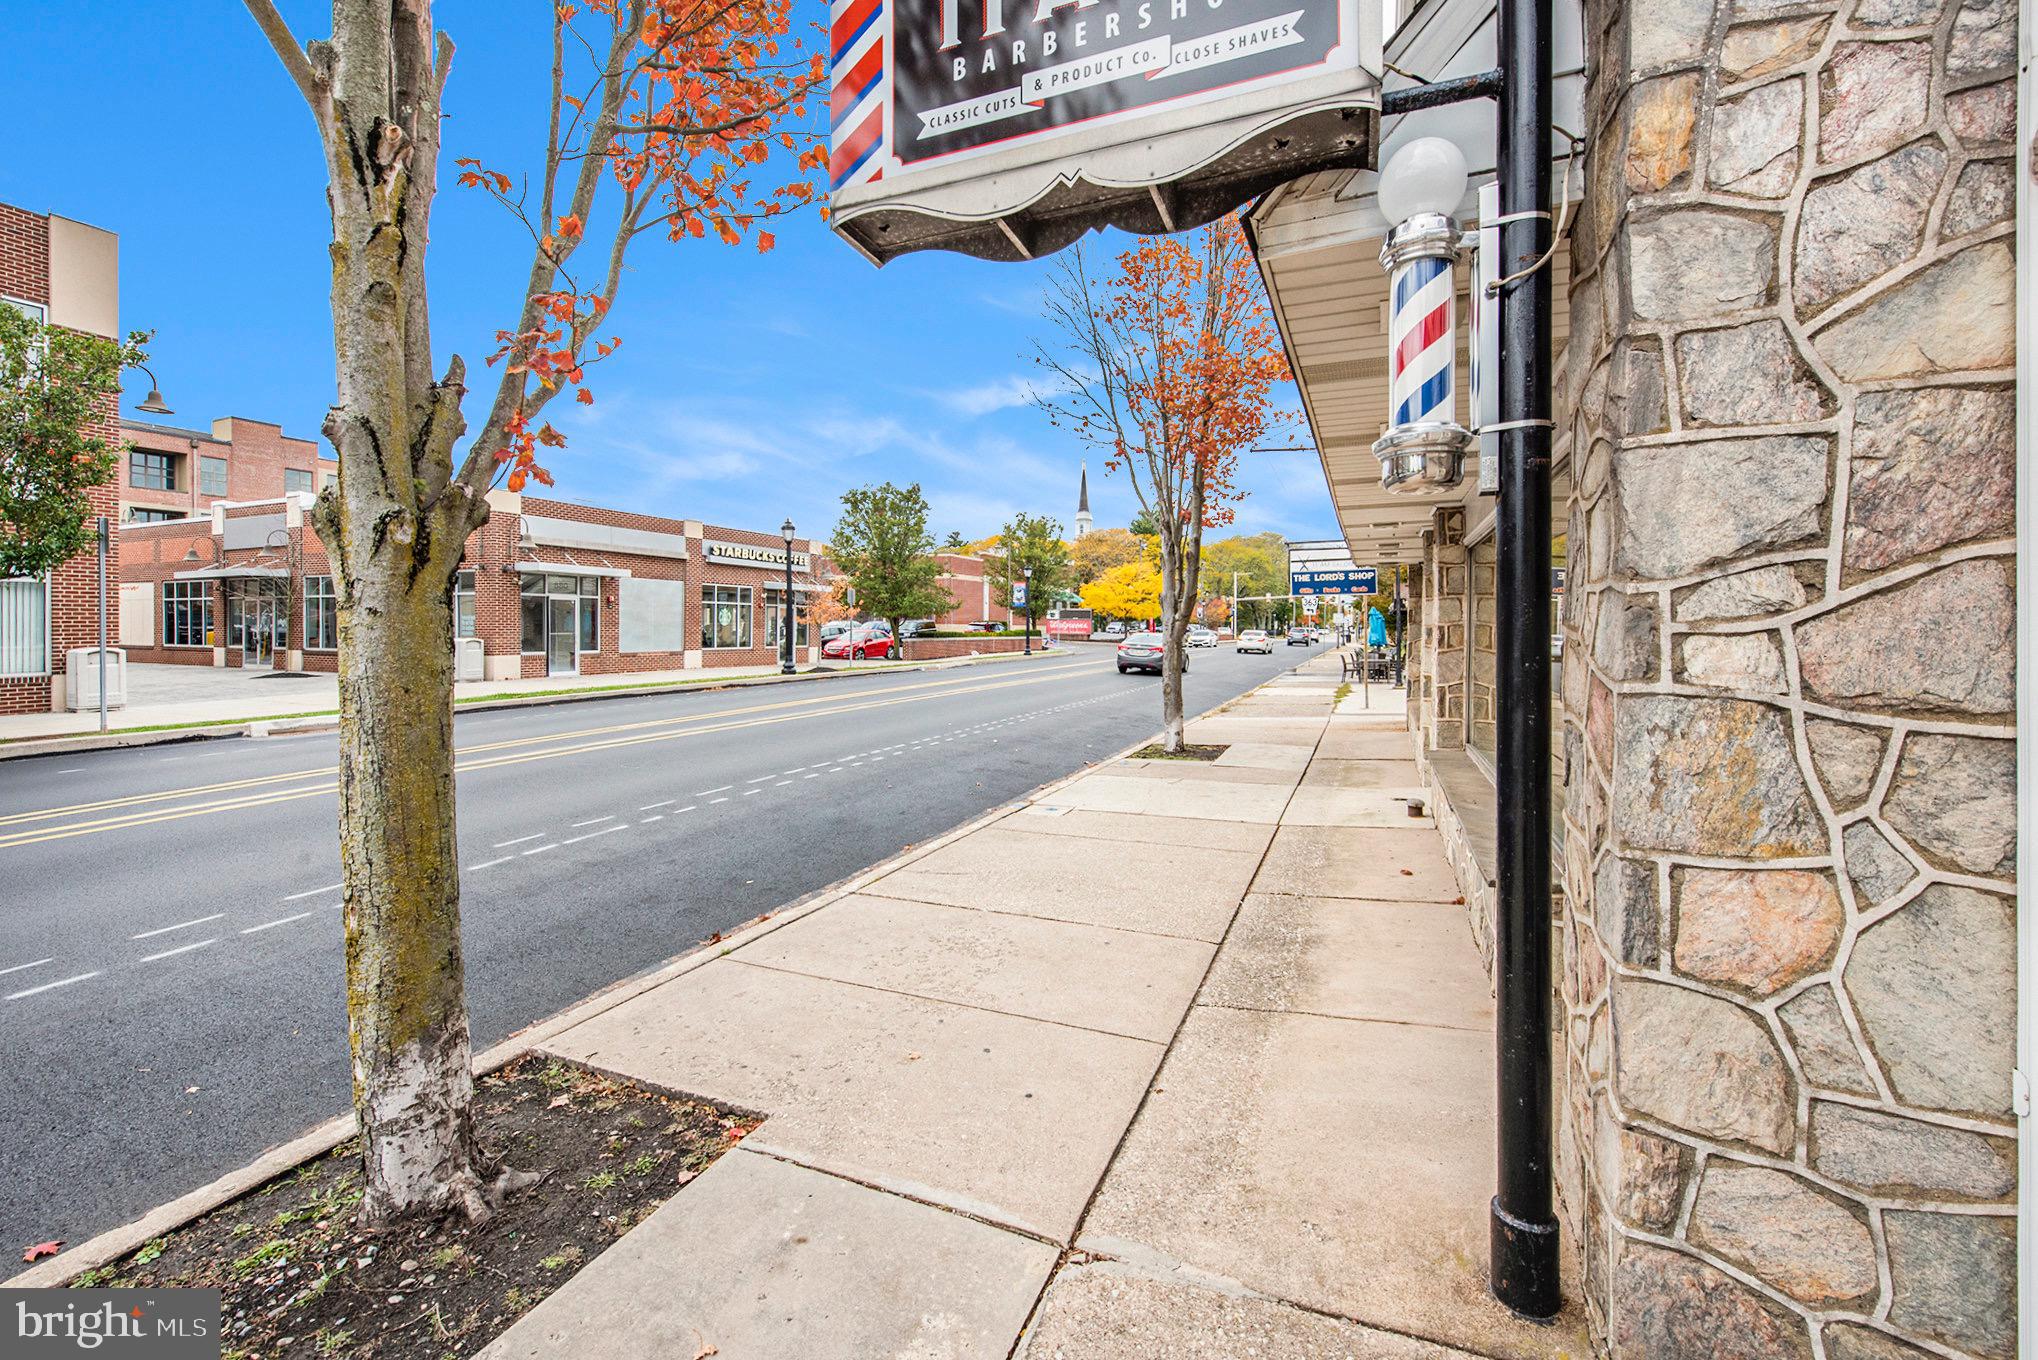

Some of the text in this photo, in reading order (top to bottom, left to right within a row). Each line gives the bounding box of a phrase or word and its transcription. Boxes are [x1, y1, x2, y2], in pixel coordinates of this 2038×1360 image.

[1175, 24, 1289, 64] CLOSE SHAVES
[1034, 78, 1043, 91] &
[1051, 56, 1123, 87] PRODUCT
[929, 96, 1016, 129] CLASSIC CUTS
[712, 544, 810, 566] STARBUCKS COFEE
[1314, 572, 1346, 582] LORD'S
[1348, 572, 1374, 580] SHOP
